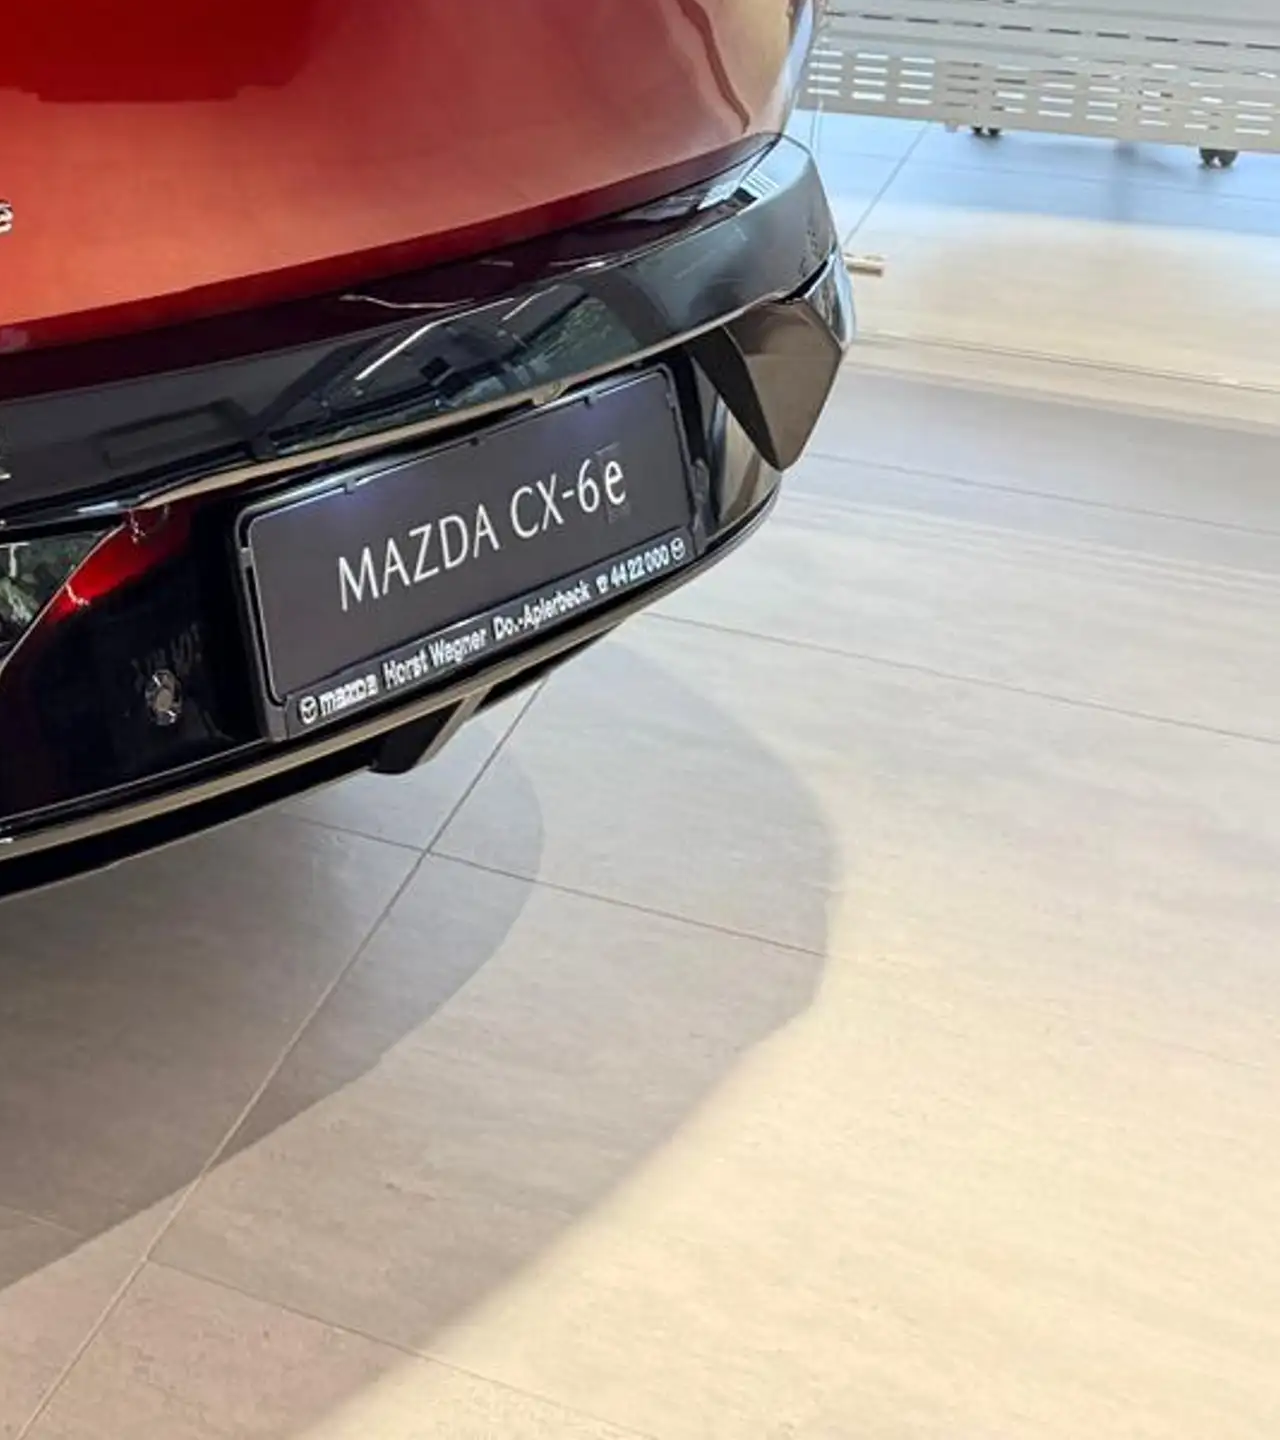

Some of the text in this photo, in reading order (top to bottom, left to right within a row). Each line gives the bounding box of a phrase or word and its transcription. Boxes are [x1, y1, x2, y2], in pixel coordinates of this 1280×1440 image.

[338, 458, 627, 612] MAZDA CX-6e
[383, 649, 428, 690] Horst
